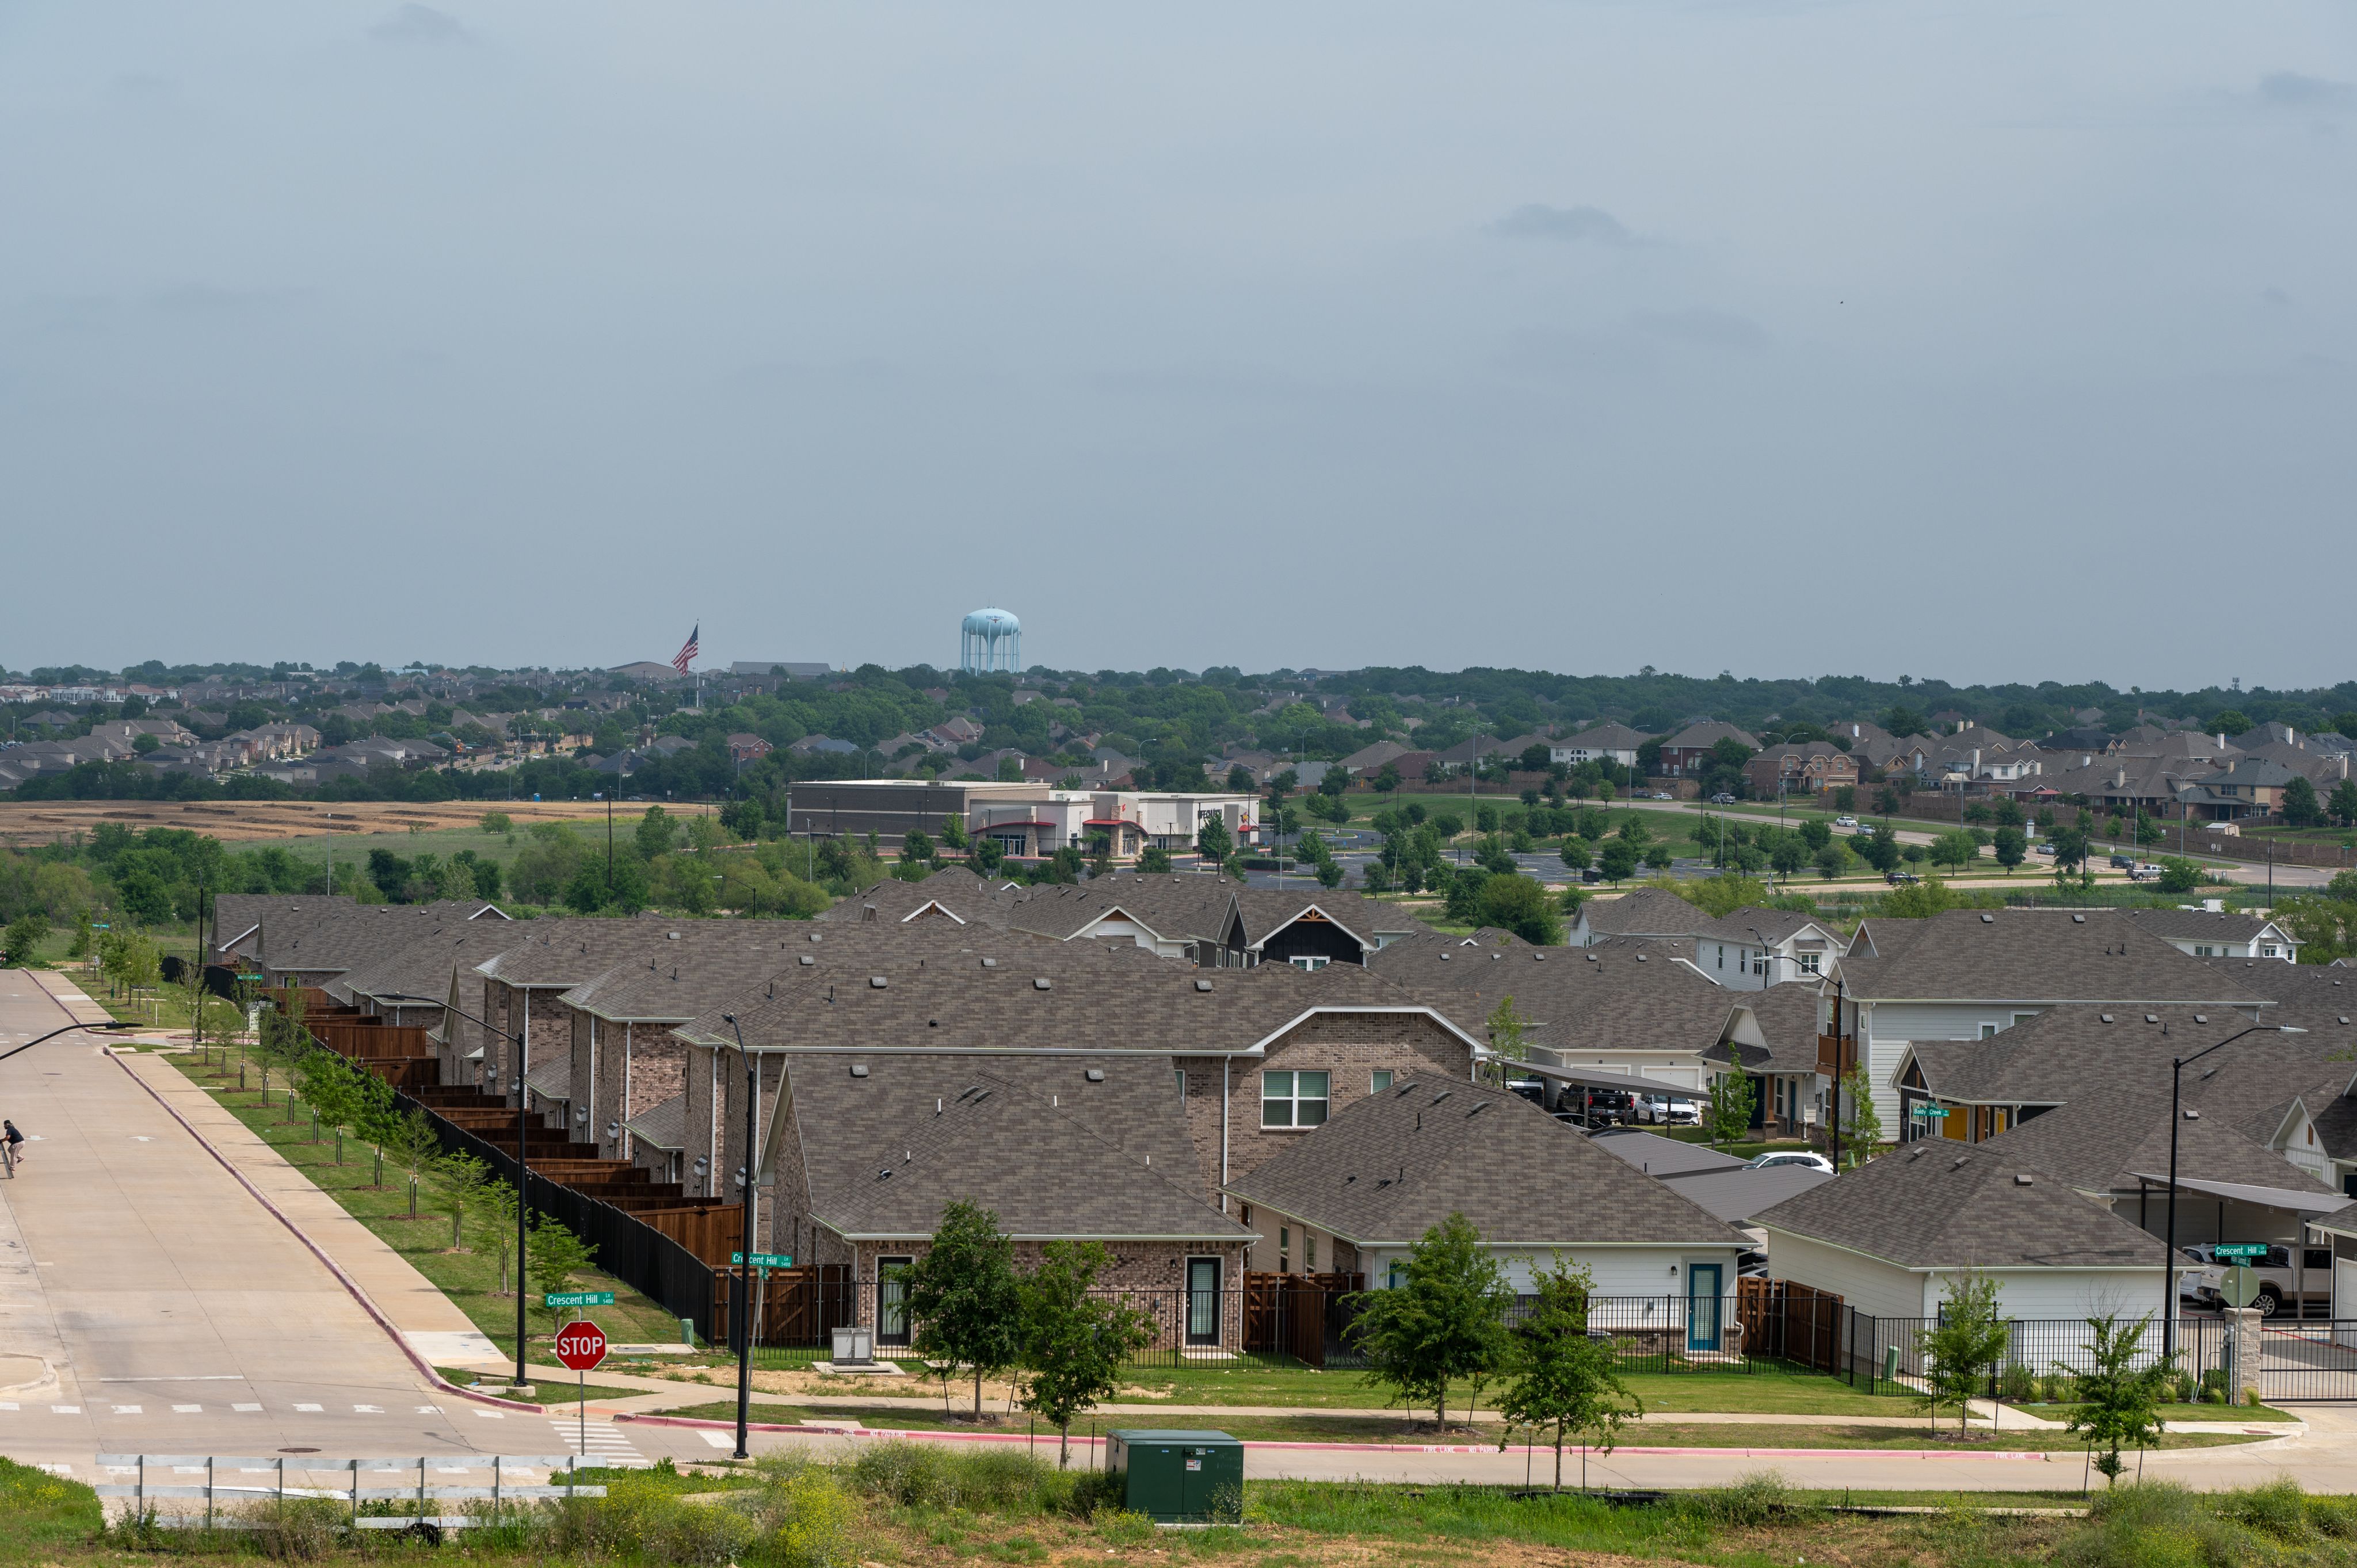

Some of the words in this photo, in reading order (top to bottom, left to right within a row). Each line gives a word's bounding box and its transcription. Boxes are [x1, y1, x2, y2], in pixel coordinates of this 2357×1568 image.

[2216, 1246, 2243, 1255] Crescent
[733, 1254, 764, 1264] Crecent
[766, 1256, 777, 1265] Hill
[548, 1295, 582, 1305] Crescent
[586, 1295, 598, 1304] Hill
[559, 1337, 602, 1356] STOP
